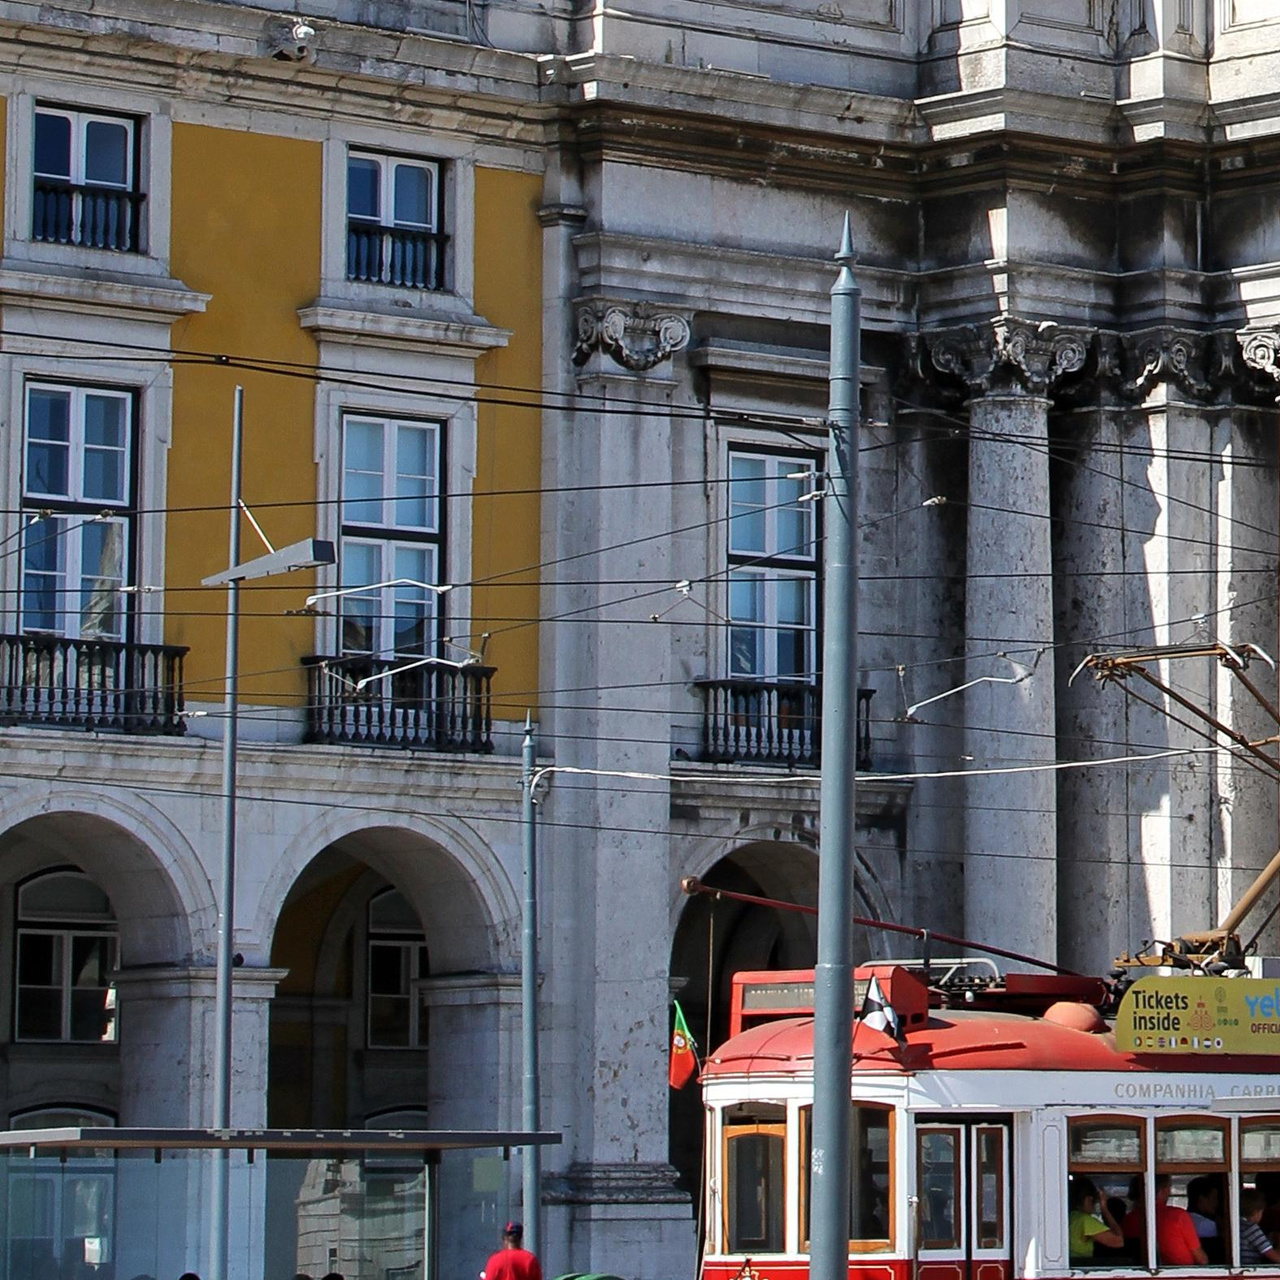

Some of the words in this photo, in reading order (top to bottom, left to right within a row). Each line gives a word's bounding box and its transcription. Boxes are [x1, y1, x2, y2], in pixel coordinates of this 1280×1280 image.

[1132, 990, 1189, 1010] Tickets
[1133, 1011, 1180, 1031] inside
[1114, 1083, 1216, 1098] COMPANHIA
